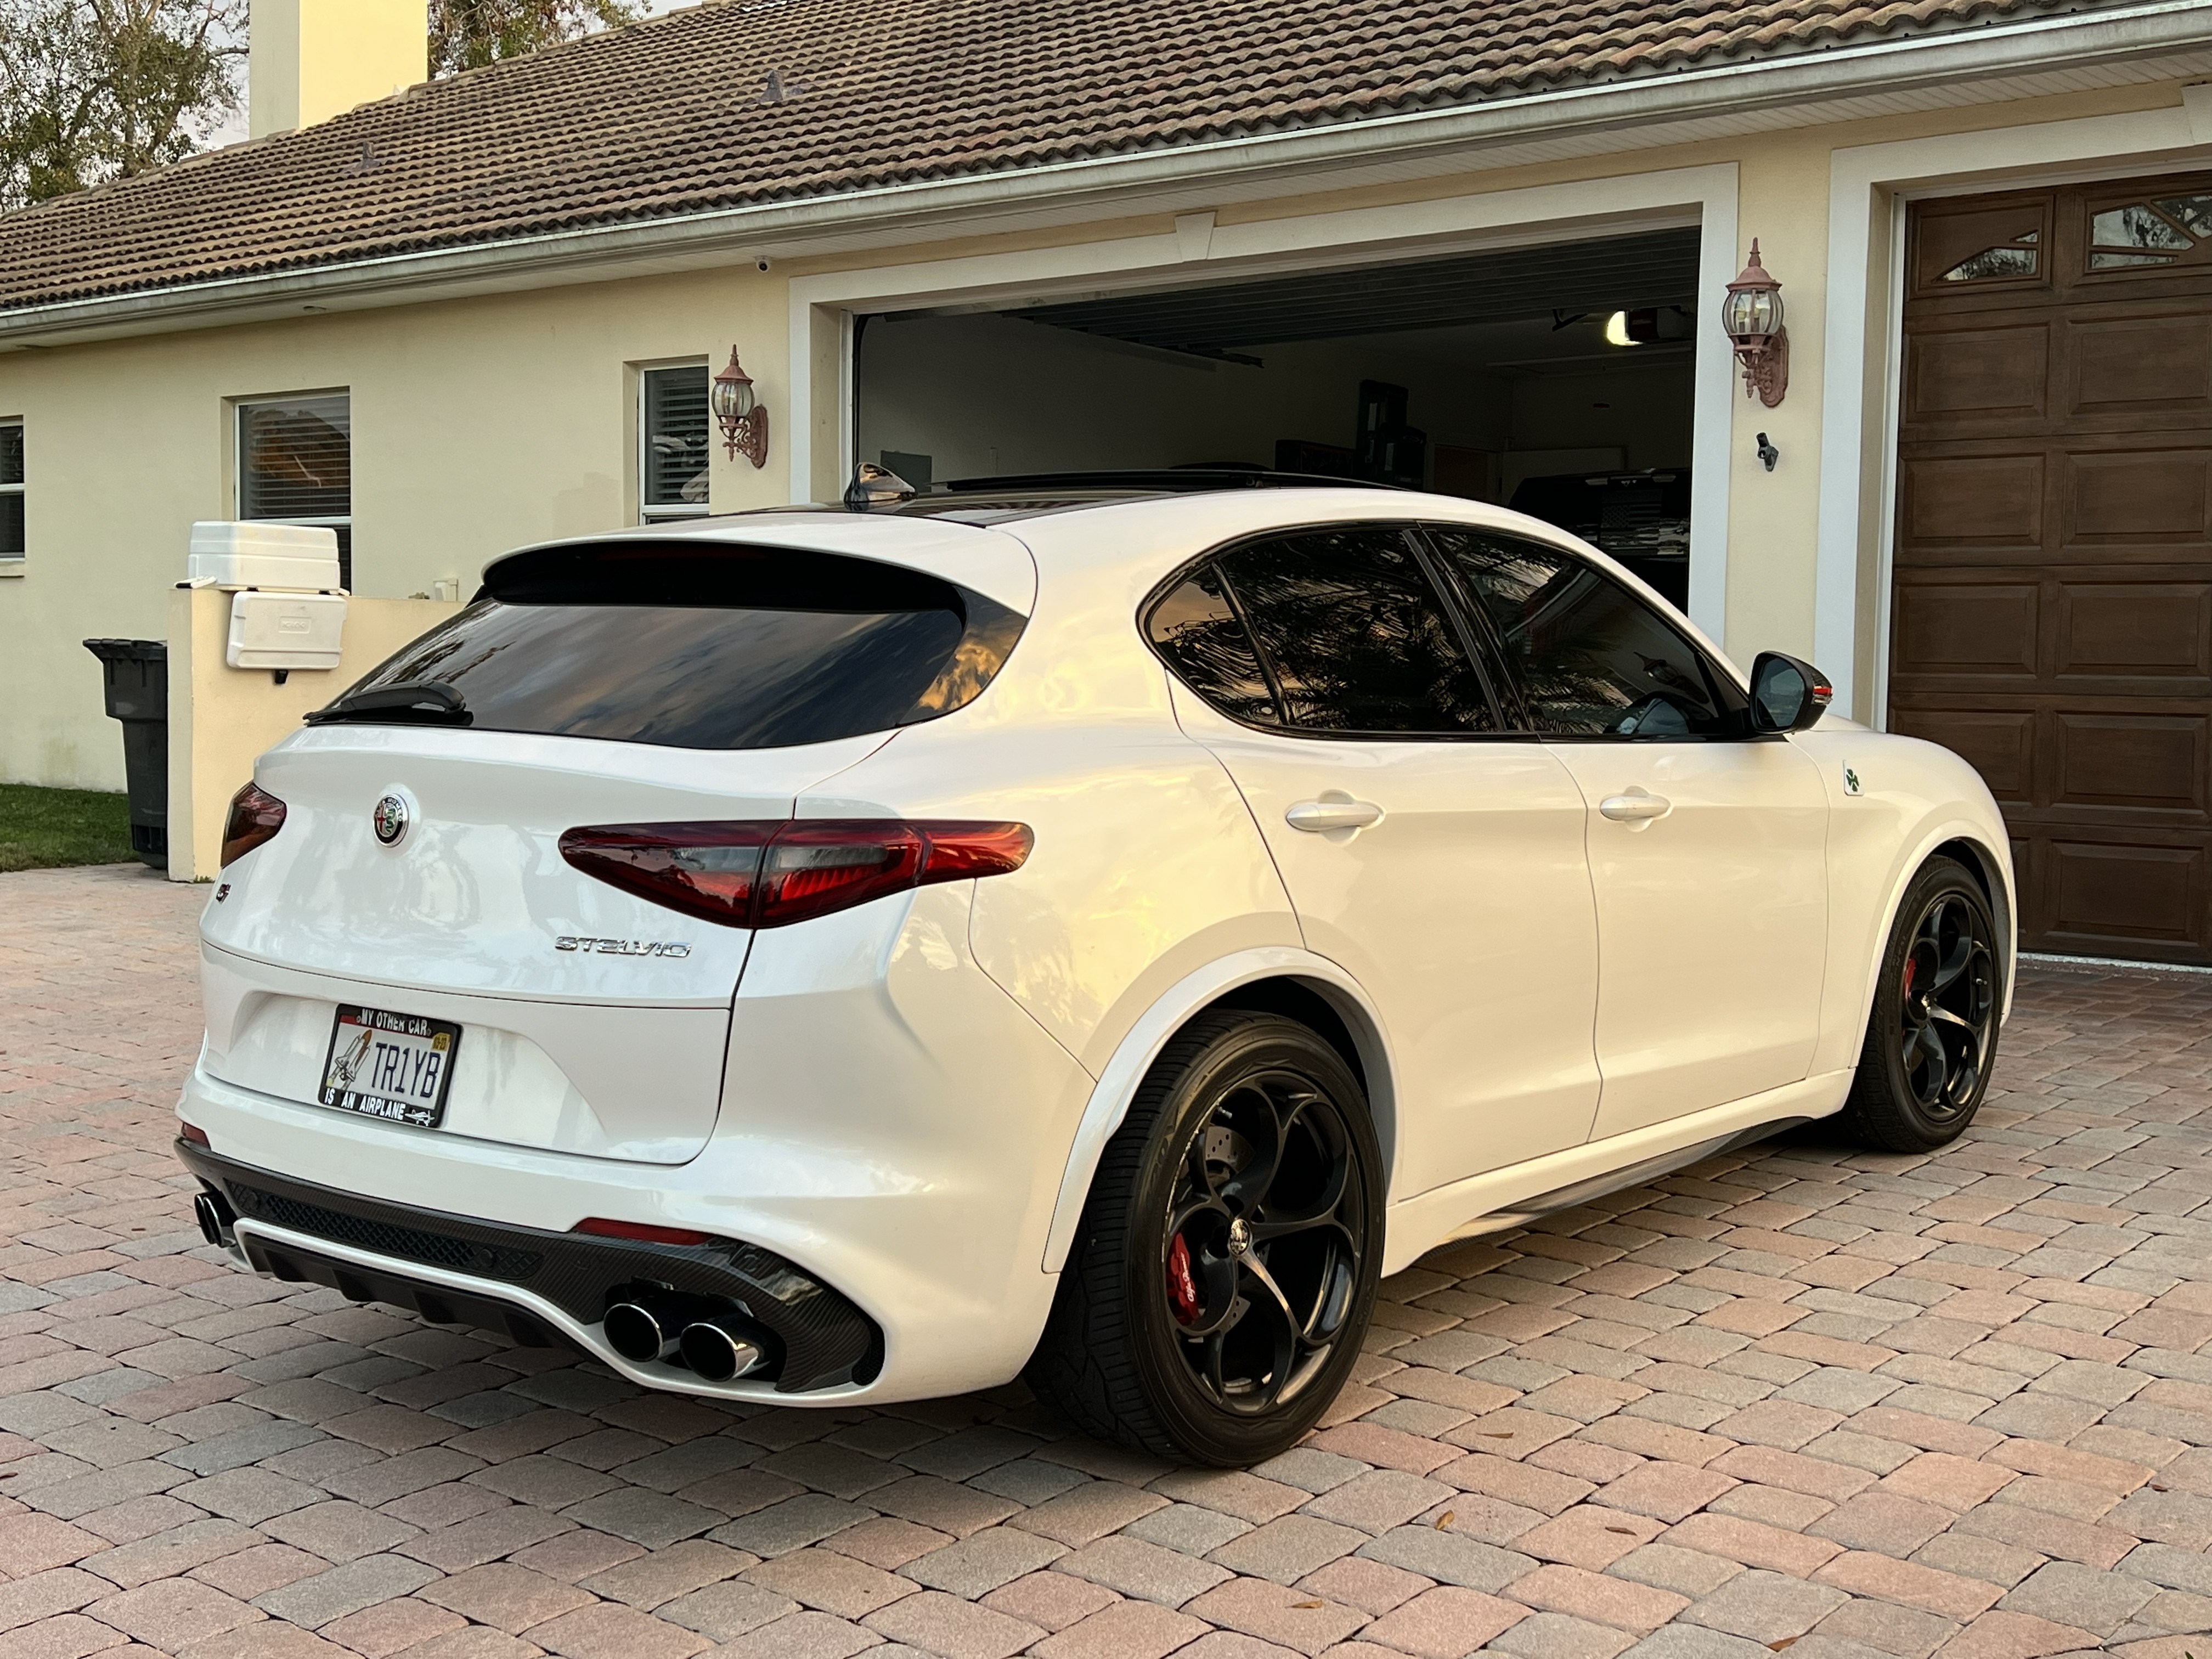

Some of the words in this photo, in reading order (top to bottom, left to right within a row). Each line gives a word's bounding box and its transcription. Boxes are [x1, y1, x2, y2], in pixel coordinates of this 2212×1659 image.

[555, 935, 692, 957] STELVIO
[361, 1008, 374, 1025] MY
[376, 1011, 405, 1032] OTHER
[408, 1018, 428, 1036] CAR
[371, 1042, 441, 1099] TR1YB
[324, 1087, 336, 1104] IS
[341, 1091, 357, 1109] AN
[358, 1095, 407, 1120] AIRPLANE
